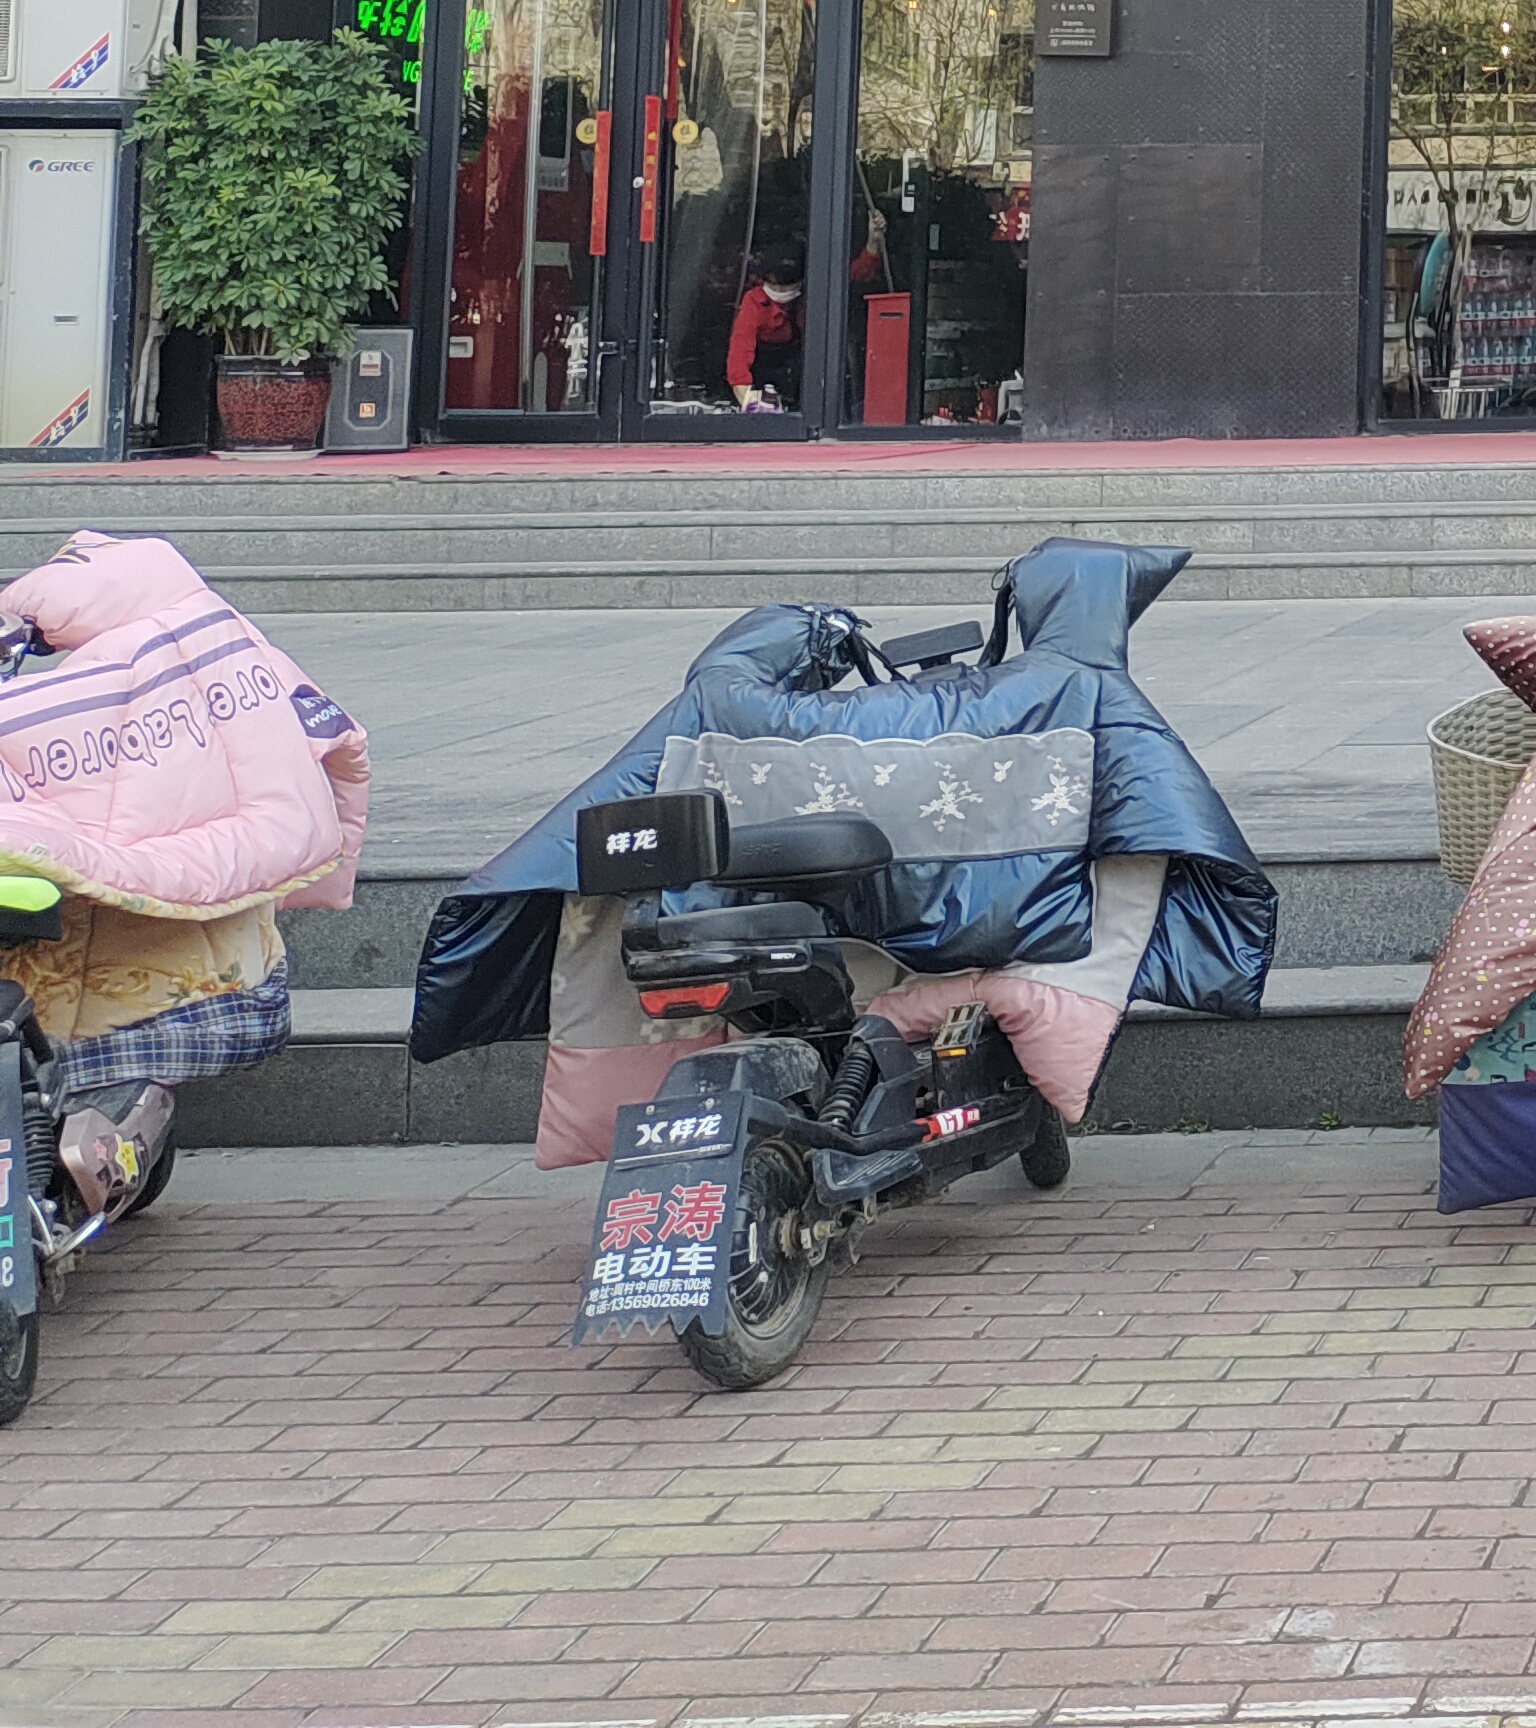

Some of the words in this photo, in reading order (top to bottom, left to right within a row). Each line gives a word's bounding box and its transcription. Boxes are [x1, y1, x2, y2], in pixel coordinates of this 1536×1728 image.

[48, 161, 95, 173] GREE
[207, 664, 285, 720] ore
[25, 699, 207, 788] Laborer
[606, 828, 658, 855] 祥龙
[669, 1114, 722, 1143] 祥龙
[599, 1180, 727, 1251] 宗涛
[593, 1242, 718, 1285] 电动车
